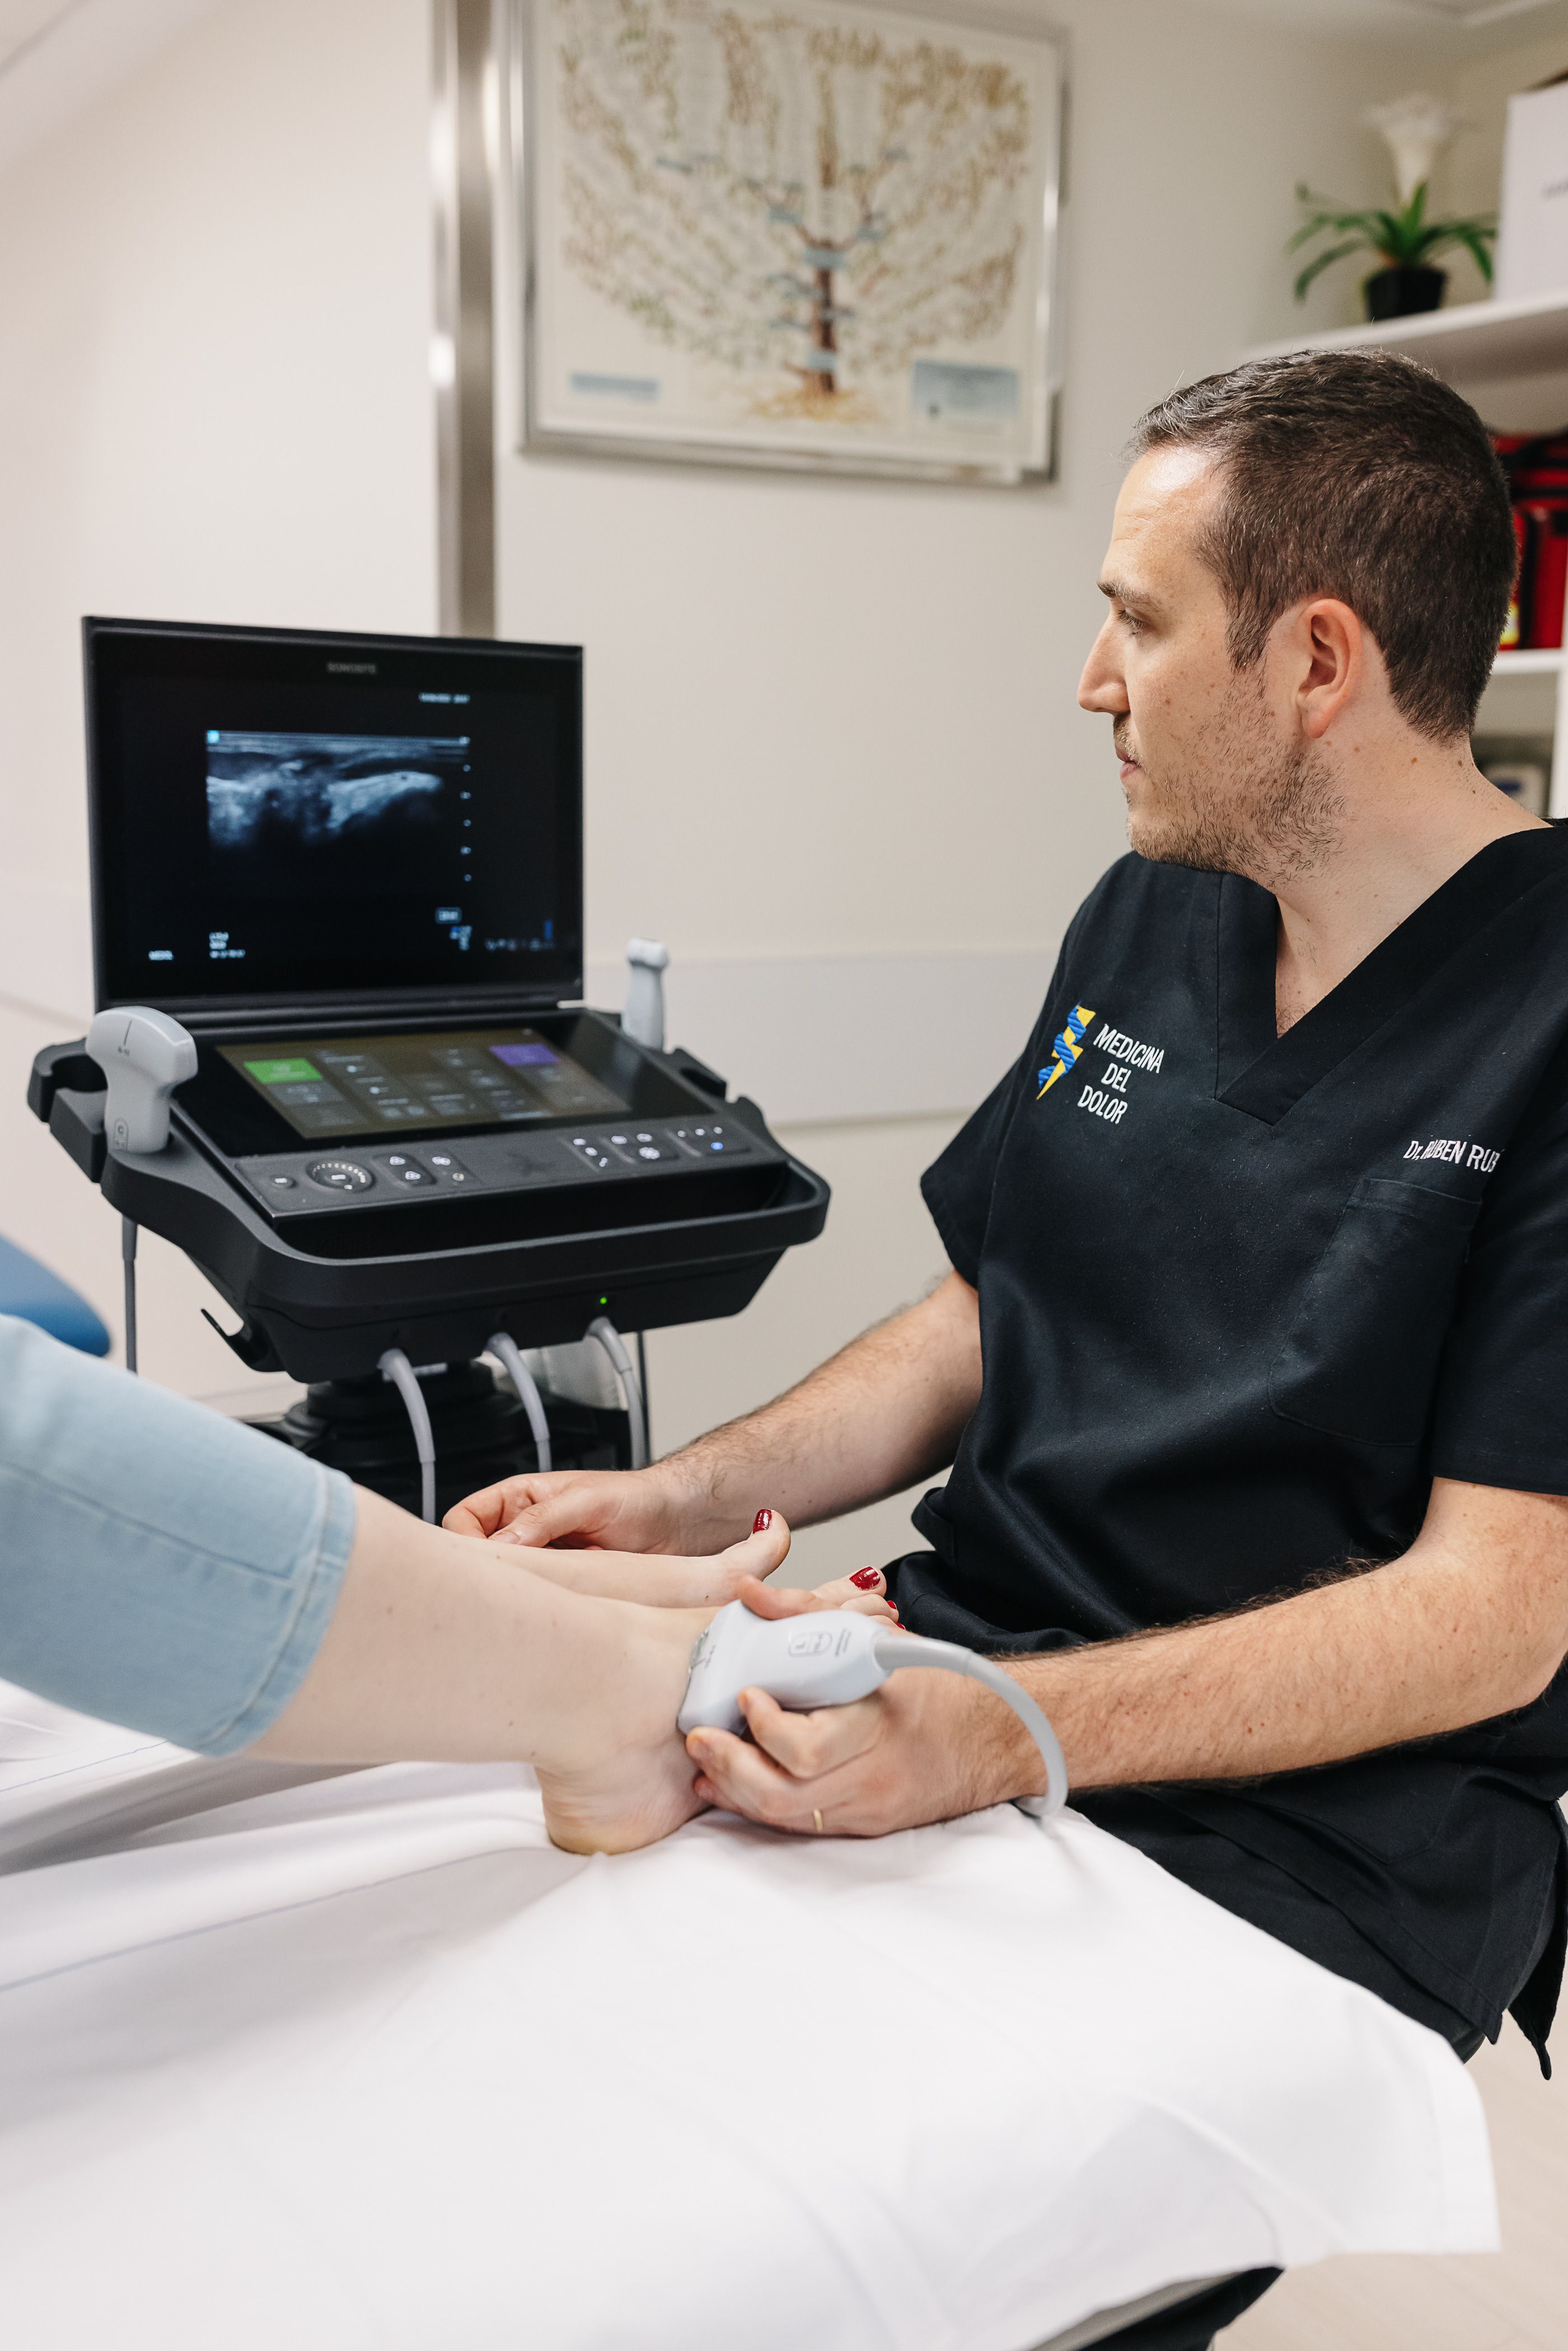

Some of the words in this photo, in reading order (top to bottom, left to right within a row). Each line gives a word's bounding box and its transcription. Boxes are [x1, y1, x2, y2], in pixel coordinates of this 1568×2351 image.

[1093, 1023, 1164, 1074] MEDICINA
[1101, 1062, 1132, 1093] DEL
[1077, 1085, 1128, 1125] DOLOR
[1420, 1139, 1467, 1164] RUBEN
[1466, 1144, 1506, 1173] RUB
